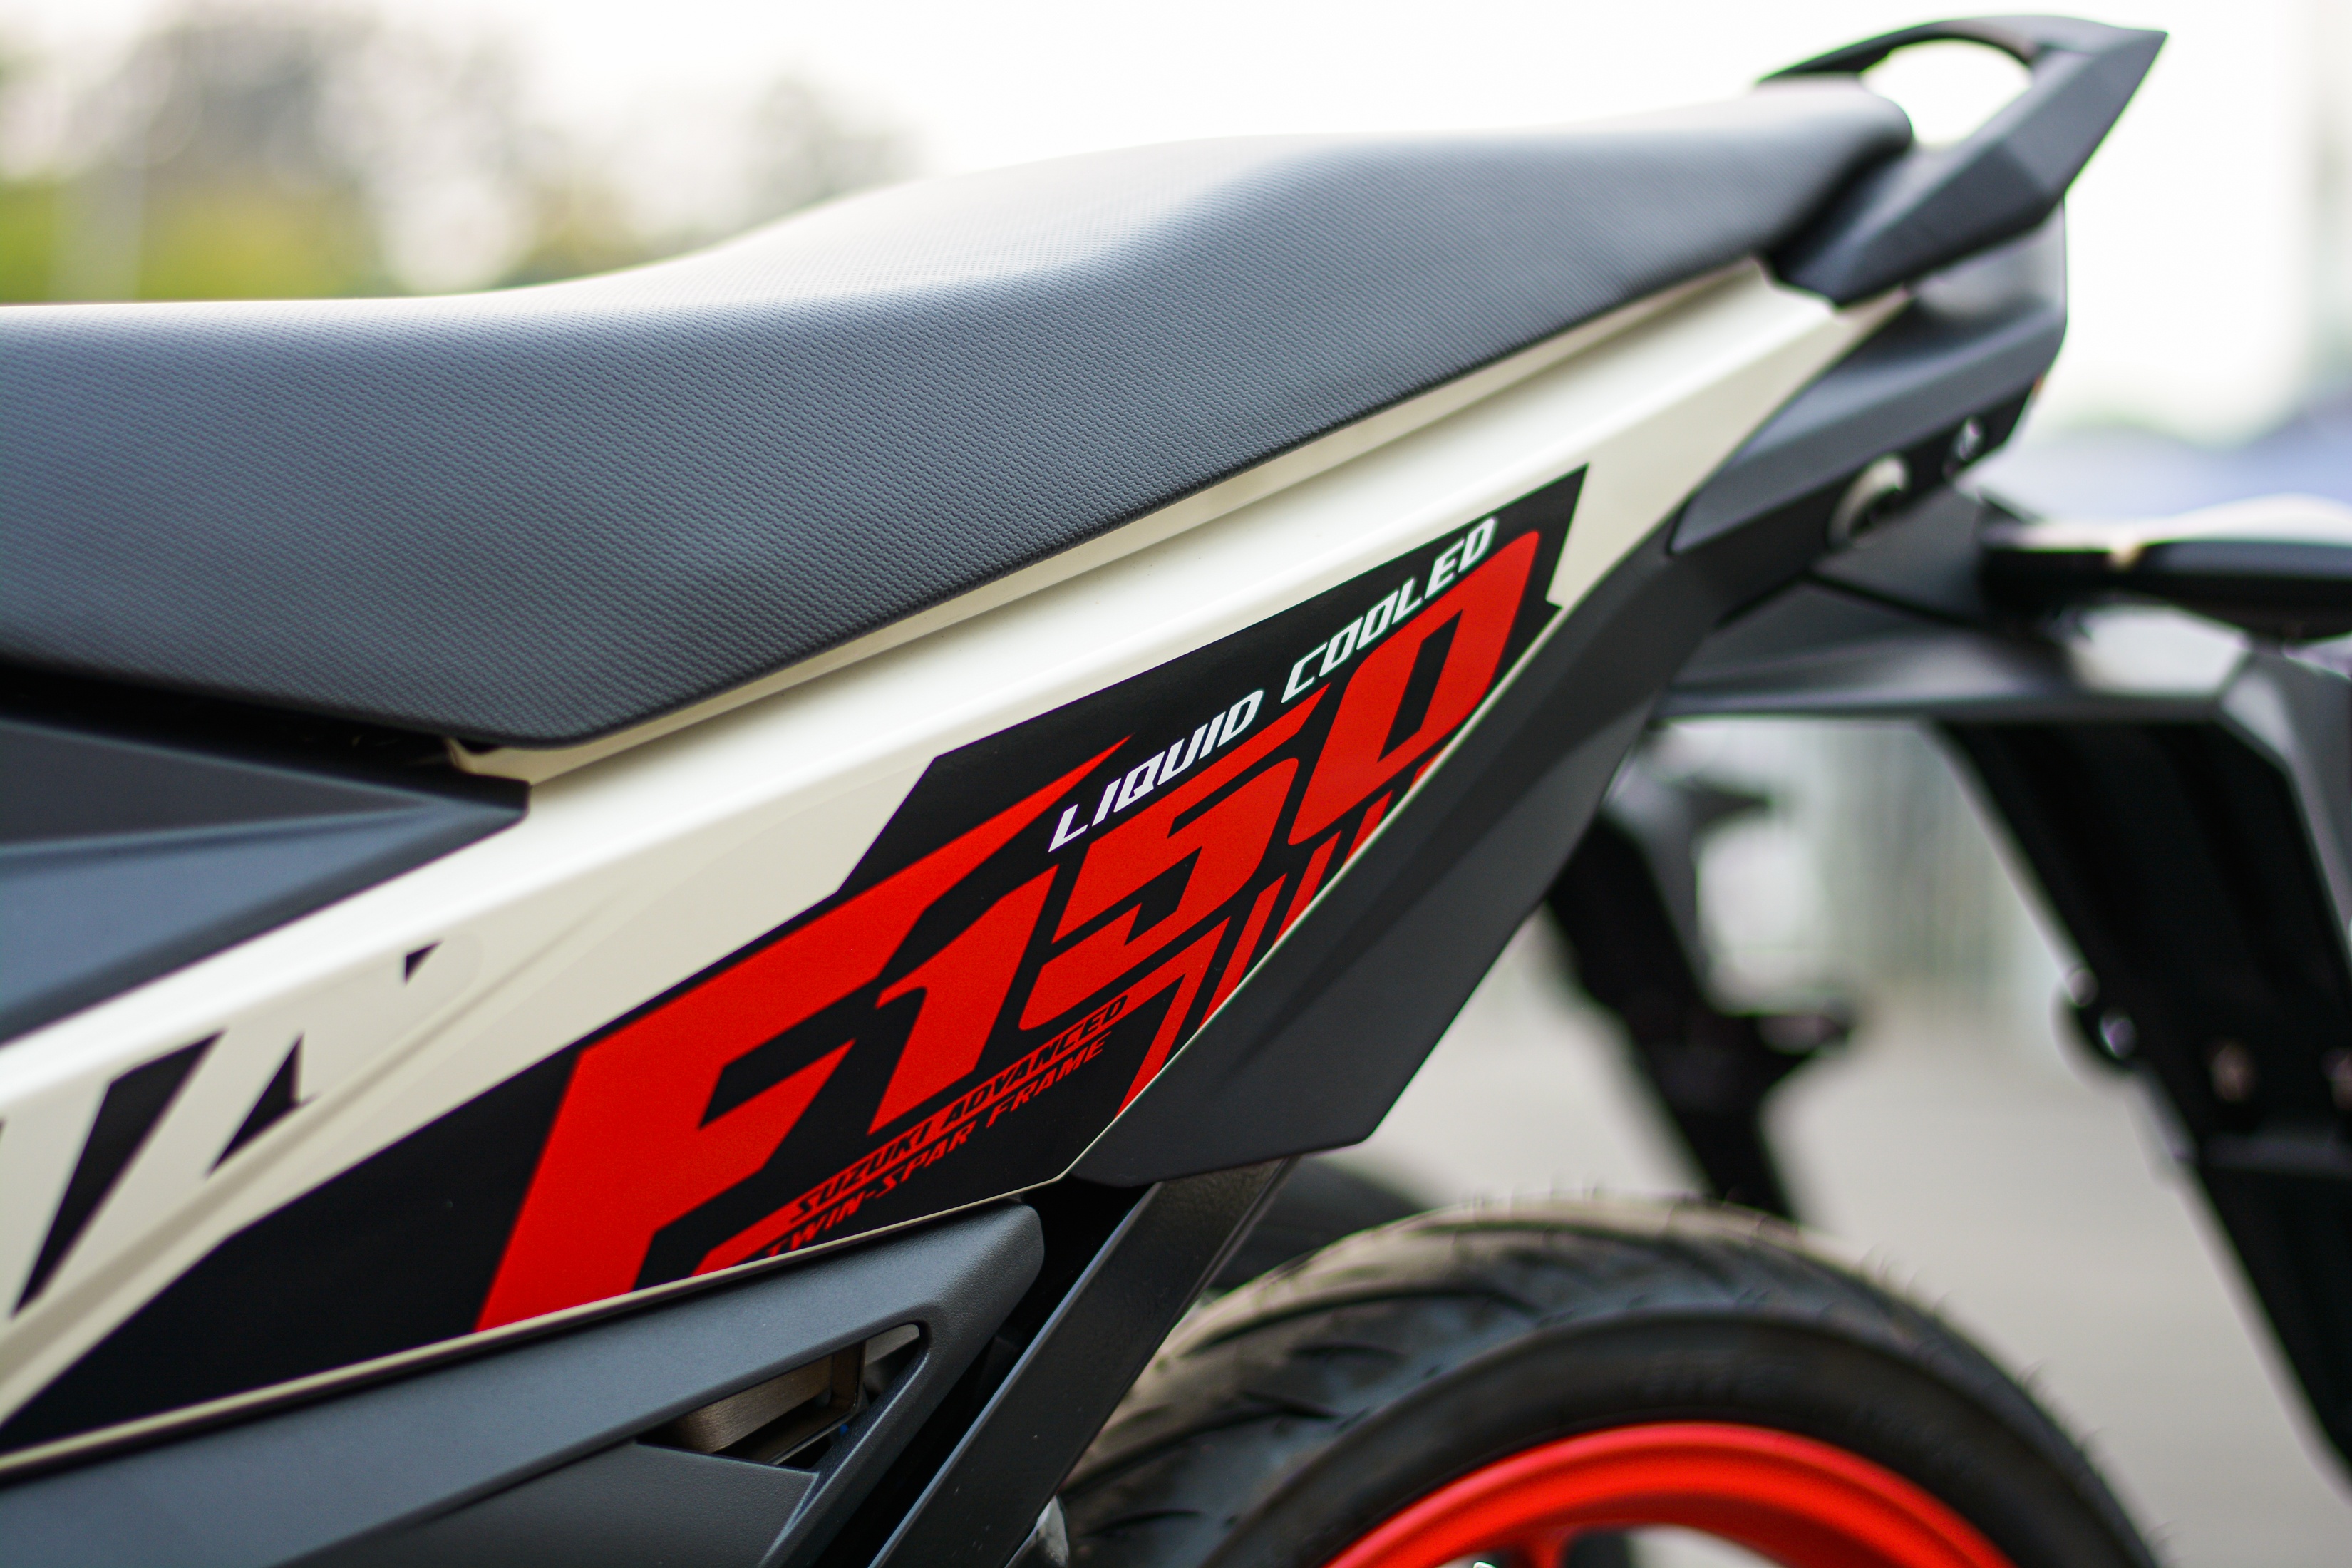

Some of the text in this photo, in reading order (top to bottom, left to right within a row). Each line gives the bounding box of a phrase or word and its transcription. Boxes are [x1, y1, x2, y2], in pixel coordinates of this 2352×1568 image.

[1047, 517, 1498, 854] LIQUID COOLED
[473, 530, 1541, 1334] F150
[765, 1031, 1113, 1259] TWIN-SPAR FRAME
[788, 994, 1128, 1224] SUZUKI ADVANCED
